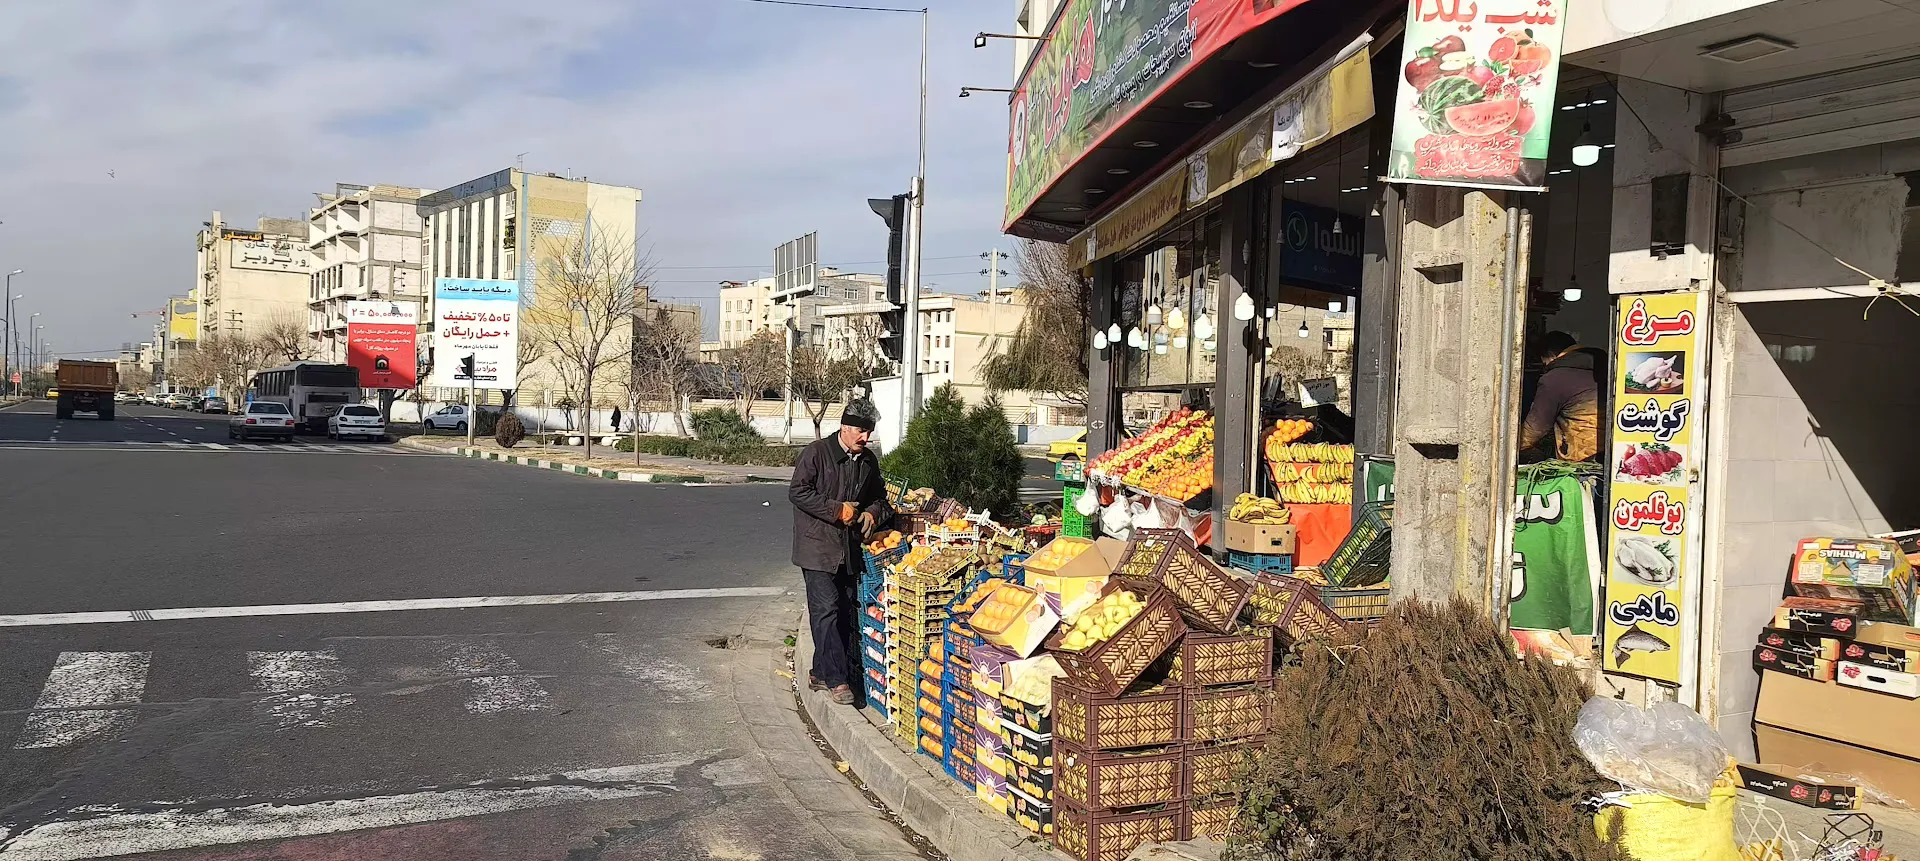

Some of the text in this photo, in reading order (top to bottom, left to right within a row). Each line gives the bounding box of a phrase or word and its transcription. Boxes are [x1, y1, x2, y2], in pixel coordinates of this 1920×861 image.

[1415, 0, 1557, 35] شب یلدا
[241, 252, 292, 269] پرویز
[444, 283, 511, 297] دیگه باید ساخت!
[443, 310, 476, 324] تخفیف
[503, 313, 511, 322] تا
[1623, 299, 1693, 344] مرغ
[443, 325, 474, 340] رایگان
[475, 327, 501, 339] حمل
[1618, 399, 1689, 440] گوشت
[1615, 492, 1683, 533] بوقلمون
[1819, 549, 1867, 560] MATHIAS
[1611, 593, 1678, 625] ماهی
